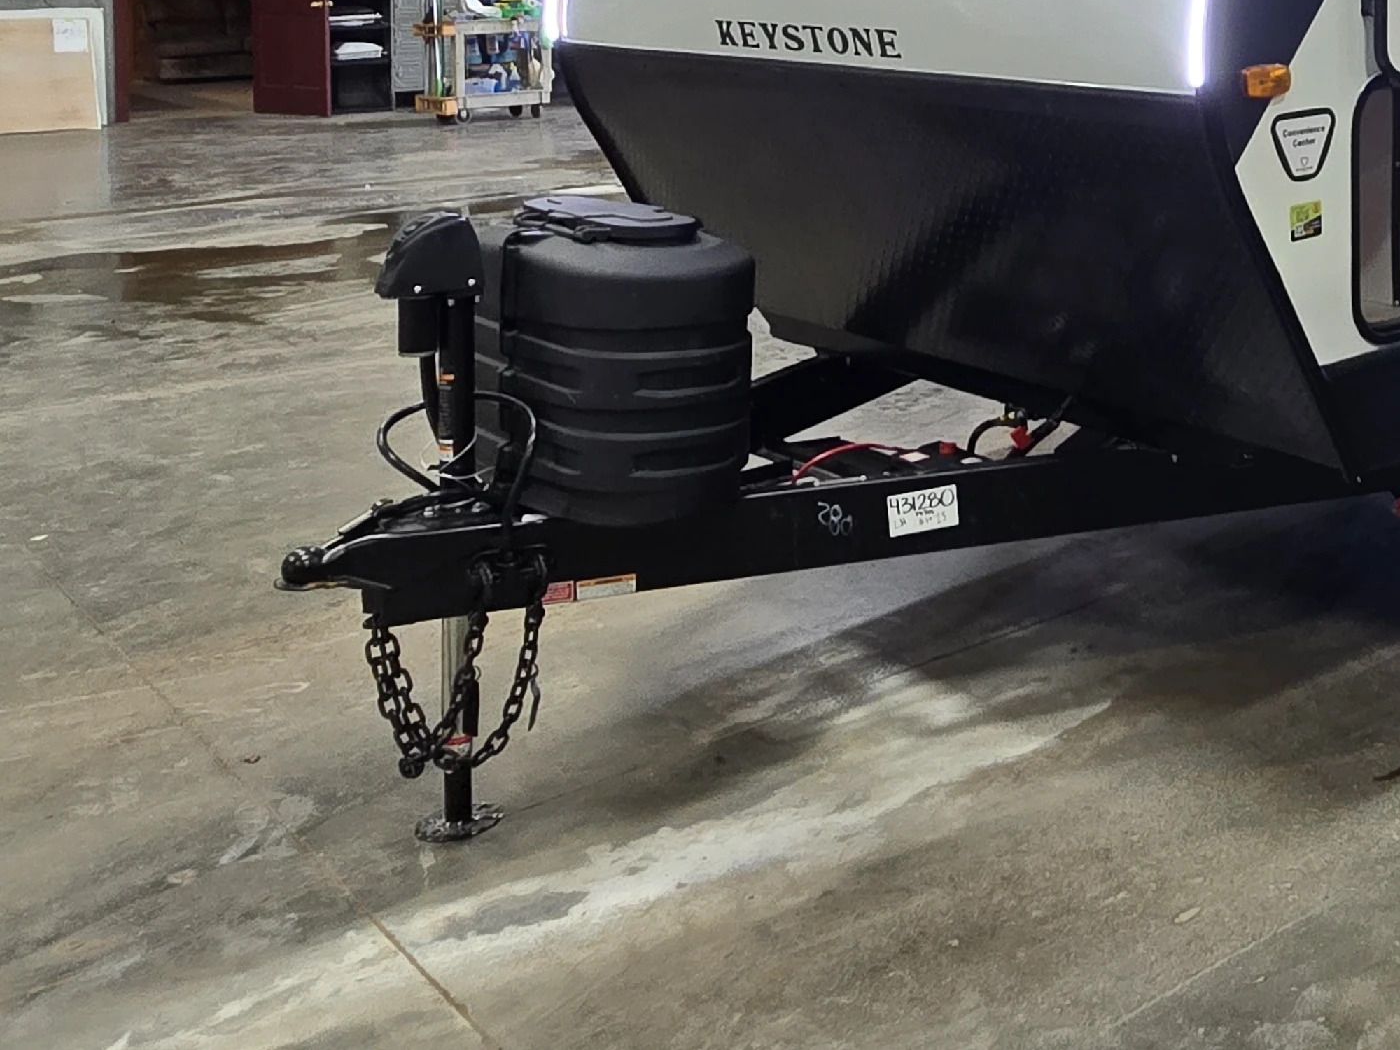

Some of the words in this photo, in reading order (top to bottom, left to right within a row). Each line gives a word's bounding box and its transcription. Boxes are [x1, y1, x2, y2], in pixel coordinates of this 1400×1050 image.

[714, 19, 902, 59] KEYSTONE
[1292, 138, 1315, 148] Center
[889, 488, 955, 515] 431280
